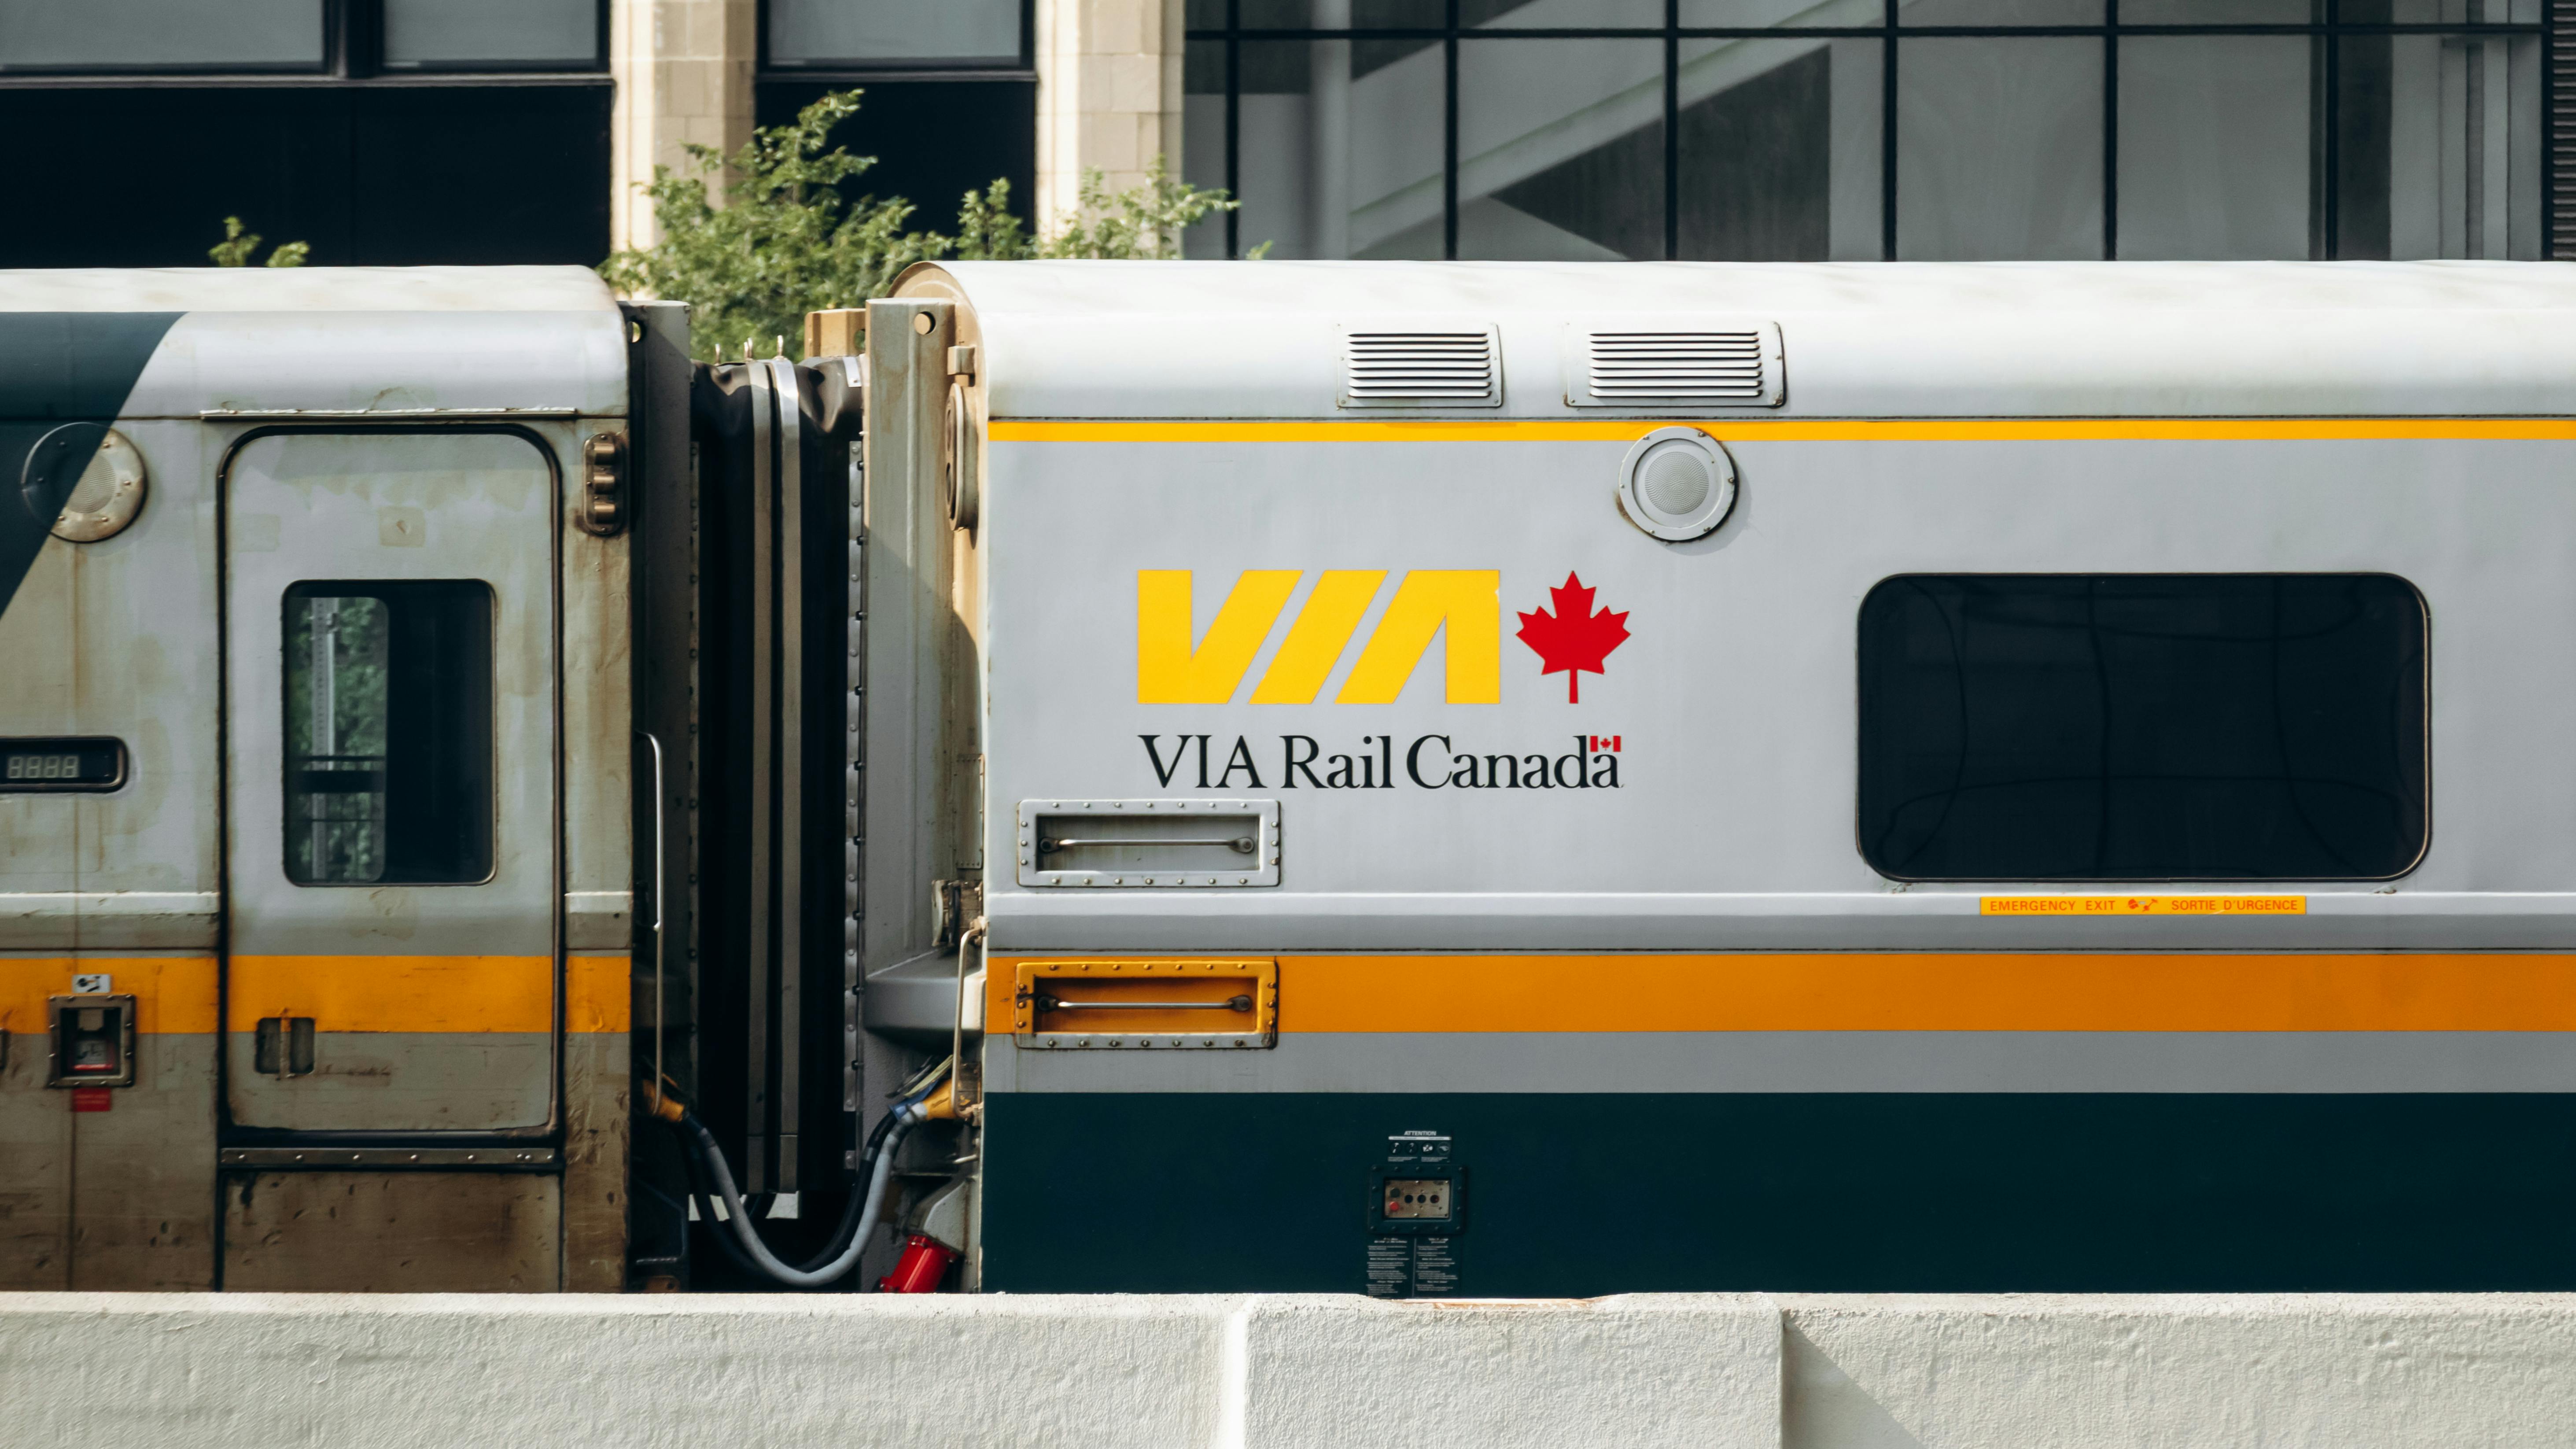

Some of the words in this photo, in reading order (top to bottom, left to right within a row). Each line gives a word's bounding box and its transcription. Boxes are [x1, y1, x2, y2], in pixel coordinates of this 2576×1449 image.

[1138, 570, 1500, 704] VIA
[1138, 735, 1267, 788] VIA
[1279, 735, 1395, 789] Rail
[1407, 734, 1619, 789] Canada
[1990, 900, 2075, 911] EMERGENCY
[2086, 900, 2115, 911] EXIT
[2171, 900, 2216, 911] SORTIE
[2223, 900, 2298, 911] D'URGENCE
